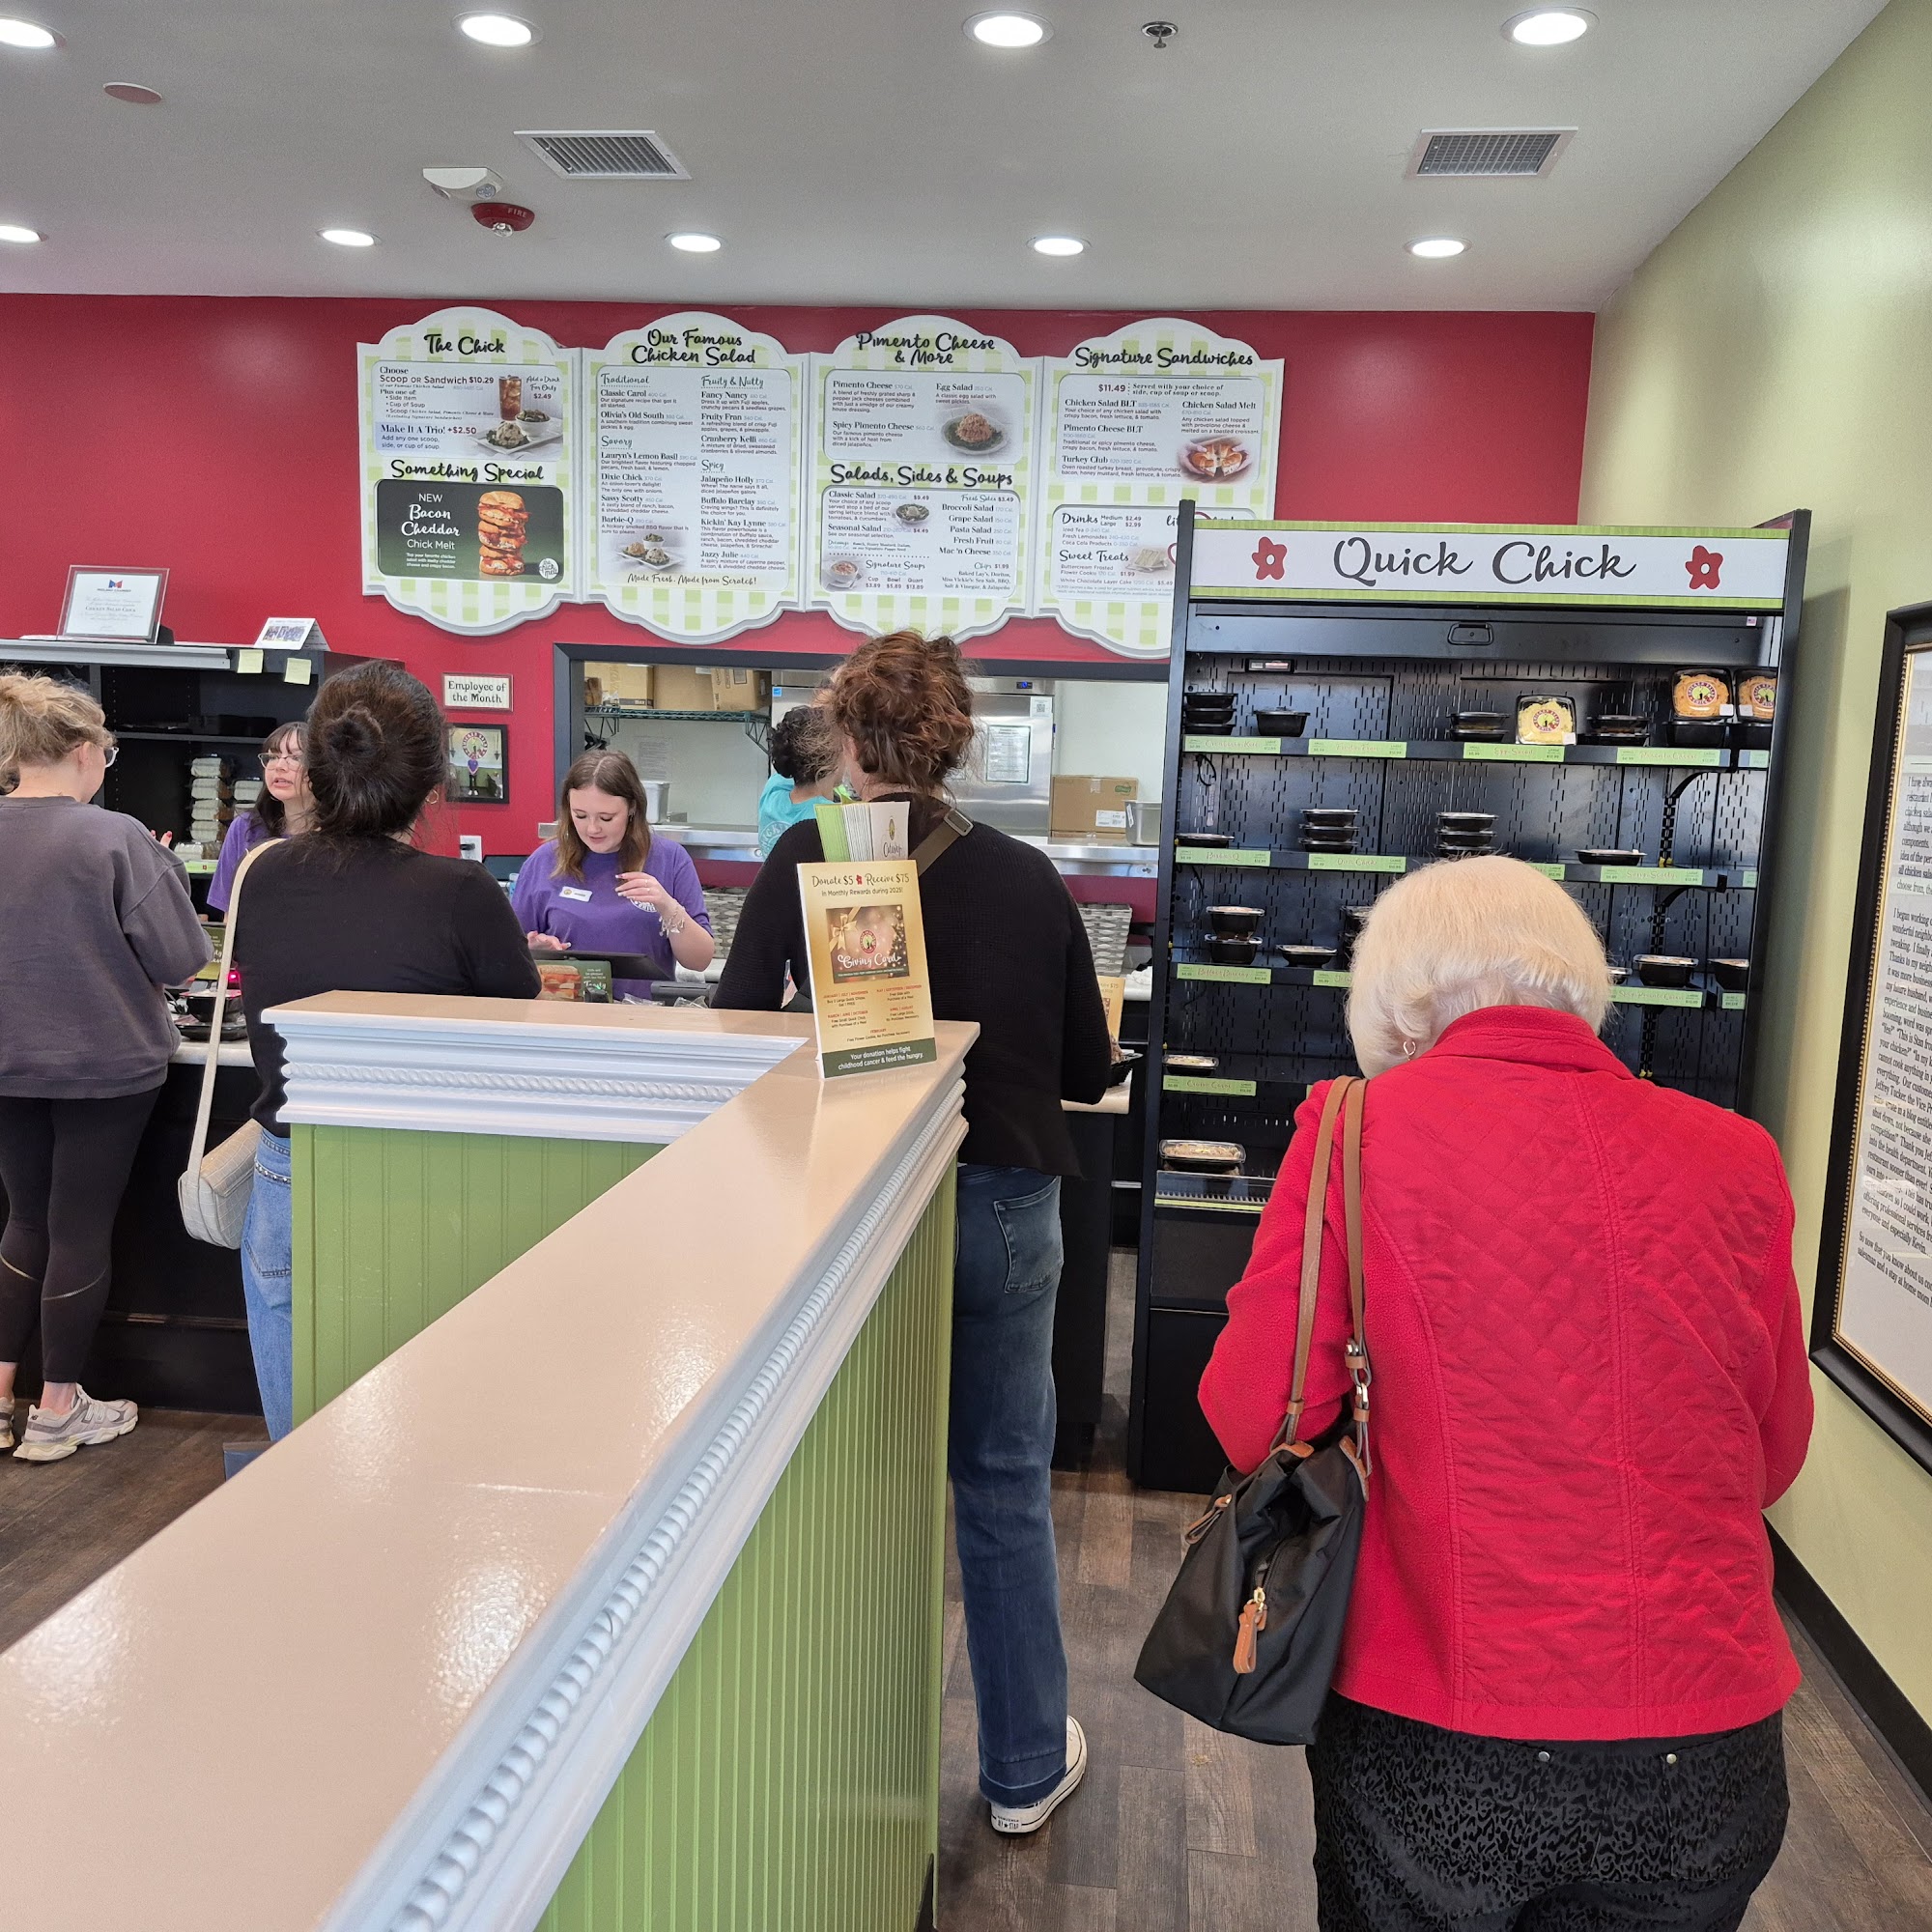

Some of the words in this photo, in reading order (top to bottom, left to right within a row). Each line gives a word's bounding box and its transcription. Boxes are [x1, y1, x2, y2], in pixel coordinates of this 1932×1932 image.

[508, 208, 526, 217] FIRE
[647, 329, 678, 346] Our
[683, 328, 742, 347] Famous
[856, 331, 929, 350] Pimento
[935, 333, 995, 352] Cheese
[424, 334, 452, 354] The
[458, 336, 505, 355] Chick
[632, 346, 699, 363] Chicken
[706, 347, 755, 366] Salad
[895, 353, 905, 362] &
[911, 350, 953, 365] More
[1075, 347, 1152, 369] Signature
[1157, 348, 1253, 368] Sandwiches
[601, 373, 649, 384] Traditional
[701, 375, 727, 386] Fruity
[729, 377, 736, 385] &
[739, 377, 763, 388] Nutty
[701, 391, 723, 400] Fancy
[724, 392, 748, 401] Nancy
[833, 421, 852, 430] Spicy
[601, 436, 633, 448] Savory
[701, 435, 737, 443] Cranberry
[601, 452, 632, 461] Lauryn's
[1063, 456, 1089, 465] Turkey
[391, 460, 478, 481] Something
[484, 463, 544, 482] Special
[701, 460, 724, 471] Spicy
[701, 476, 733, 485] Jalapeño
[735, 476, 753, 485] Holly
[831, 464, 894, 483] Salads,
[897, 466, 942, 485] Sides
[946, 468, 958, 484] &
[963, 468, 1012, 489] Soups
[418, 494, 442, 502] NEW
[410, 504, 450, 520] Bacon
[602, 516, 634, 525] Barbie-Q
[949, 515, 971, 524] Grape
[1062, 513, 1098, 525] Drinks
[401, 522, 460, 536] Cheddar
[408, 539, 433, 549] Chick
[436, 540, 455, 550] Melt
[1059, 550, 1093, 562] Sweet
[1096, 551, 1128, 562] Treats
[1334, 537, 1473, 587] Quick
[1492, 541, 1636, 584] Chick
[866, 560, 901, 570] Signature
[904, 561, 925, 570] Soups
[628, 574, 649, 583] Made
[678, 575, 700, 584] Made
[702, 576, 720, 585] from
[723, 576, 756, 585] Scratch!
[448, 681, 494, 693] Employee
[497, 683, 506, 692] of
[453, 694, 468, 702] the
[471, 694, 502, 703] Month
[811, 875, 841, 887] Donate
[844, 875, 853, 885] $5
[865, 873, 894, 886] Receive
[895, 873, 909, 883] $75
[1897, 880, 1912, 891] choose
[1911, 914, 1929, 926] working
[838, 954, 872, 968] Giving
[874, 953, 901, 966] Card
[1908, 987, 1927, 1002] husband,
[1885, 996, 1907, 1011] experience
[1914, 1034, 1923, 1048] Stan
[838, 1062, 864, 1070] childhood
[907, 1052, 923, 1061] hungry.
[1904, 1061, 1923, 1077] anything
[1875, 1078, 1889, 1094] Jeffrey
[1900, 1136, 1914, 1151] Thank
[1915, 1144, 1924, 1156] you
[1862, 1207, 1881, 1225] everyone
[1890, 1224, 1912, 1244] especially
[1859, 1231, 1864, 1242] So
[1874, 1240, 1883, 1255] that
[1858, 1246, 1876, 1265] salesman
